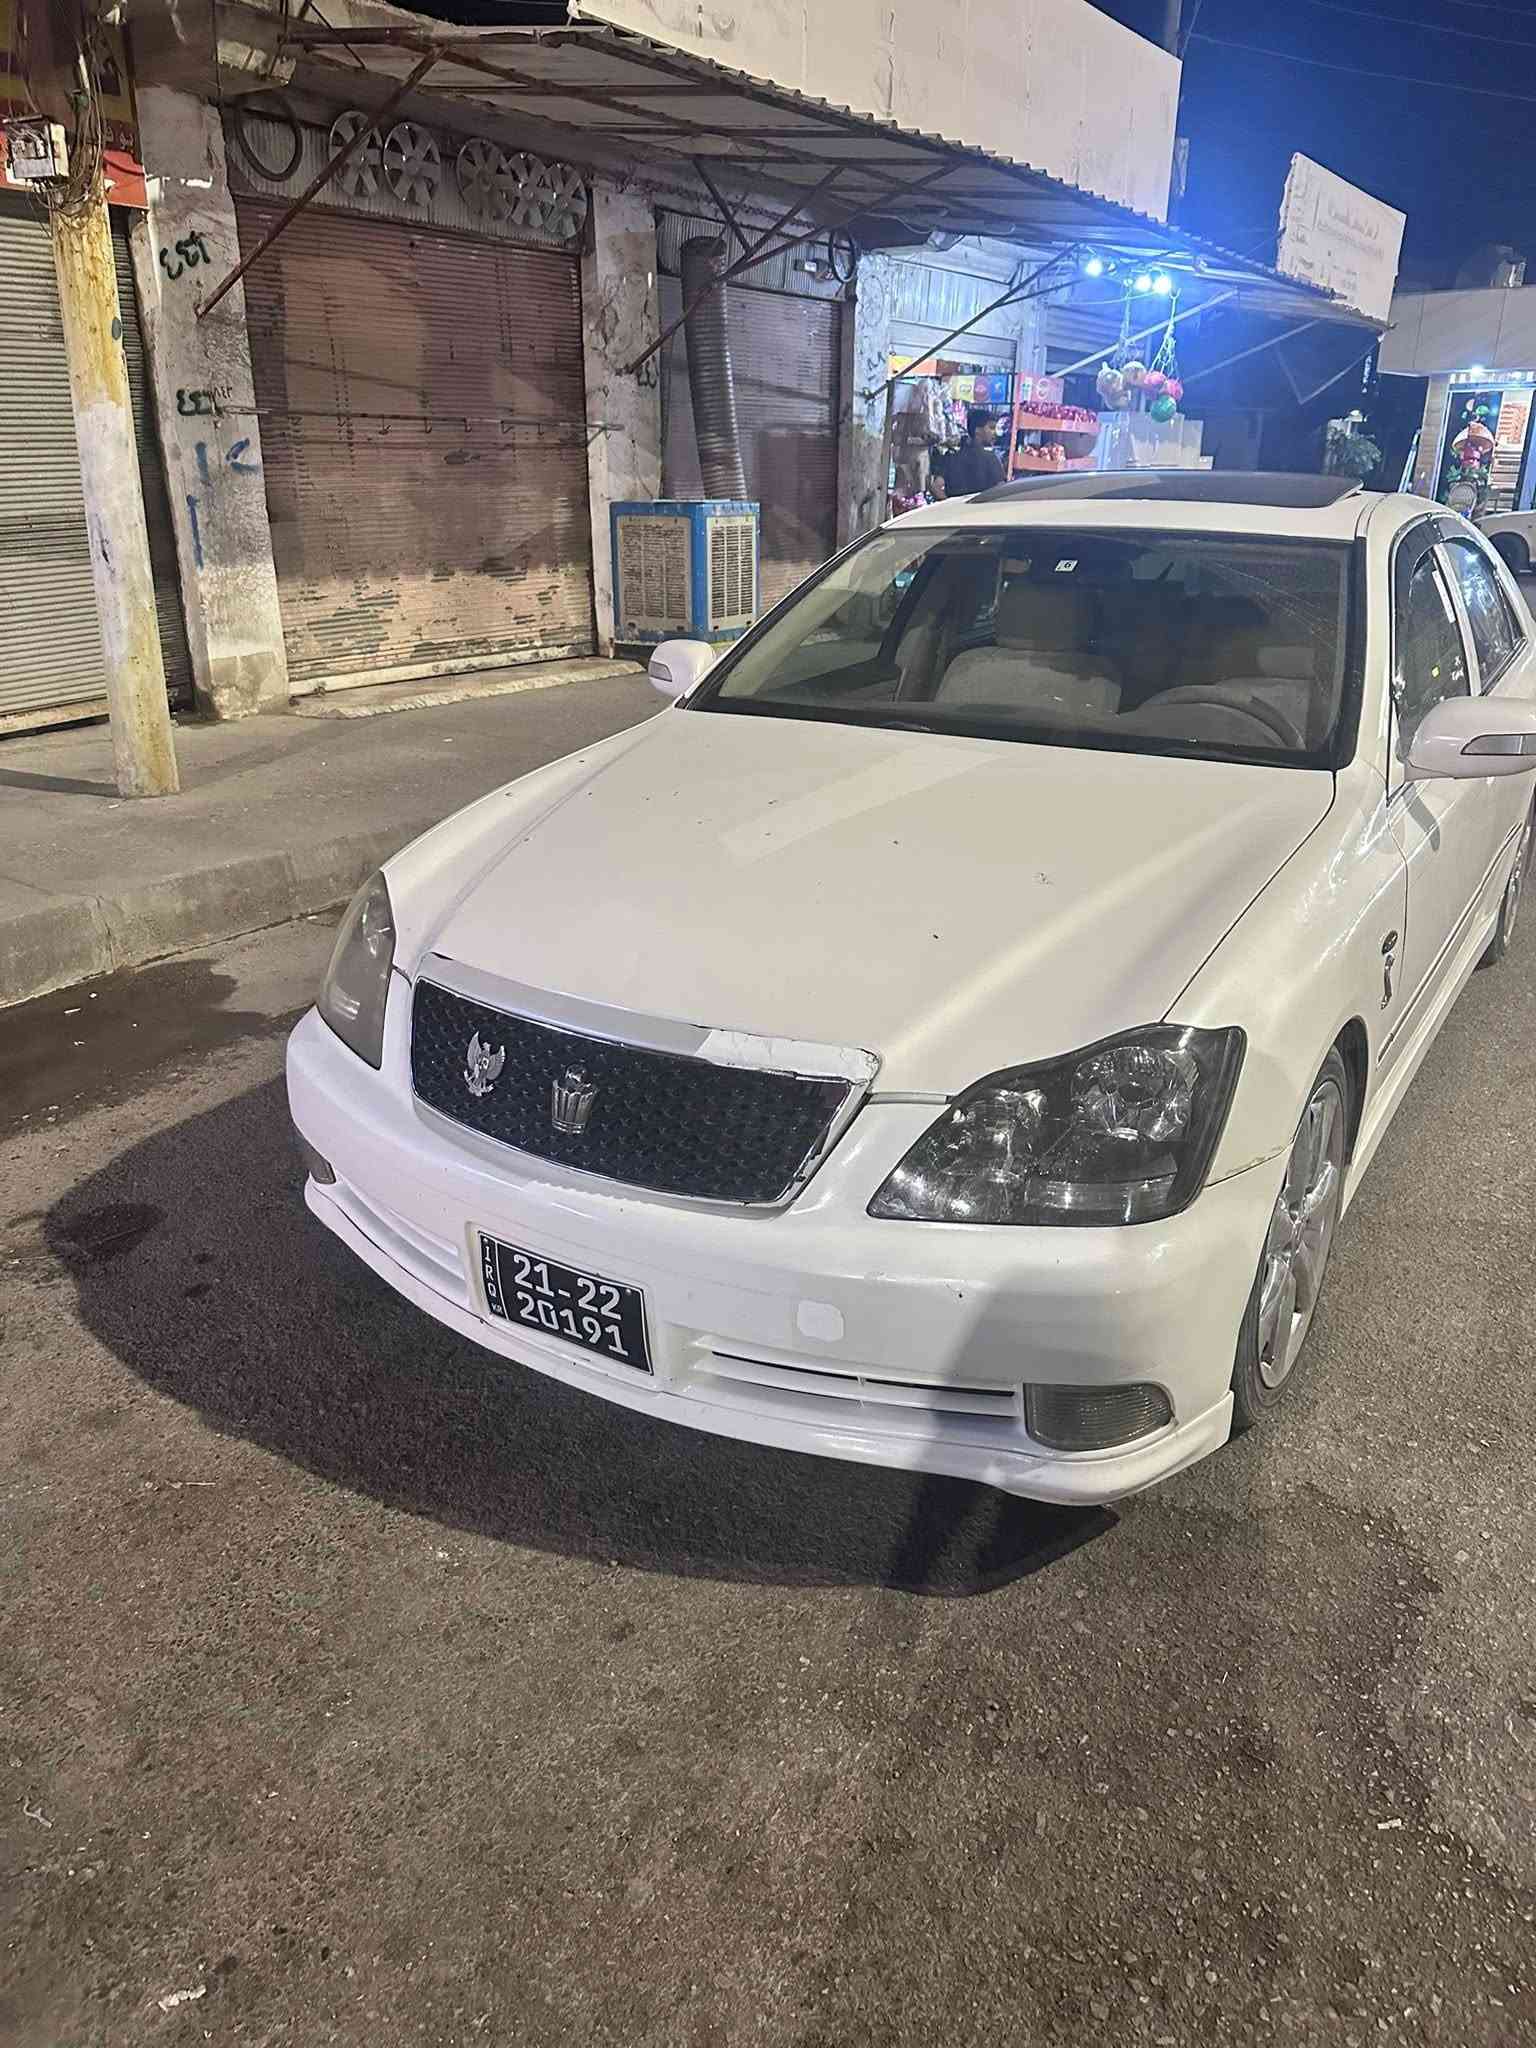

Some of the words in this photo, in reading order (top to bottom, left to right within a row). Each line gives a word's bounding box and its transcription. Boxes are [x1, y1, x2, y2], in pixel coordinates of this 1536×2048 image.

[484, 1245, 497, 1298] IRQ
[513, 1253, 623, 1321] 21-22
[516, 1290, 629, 1357] 20191
